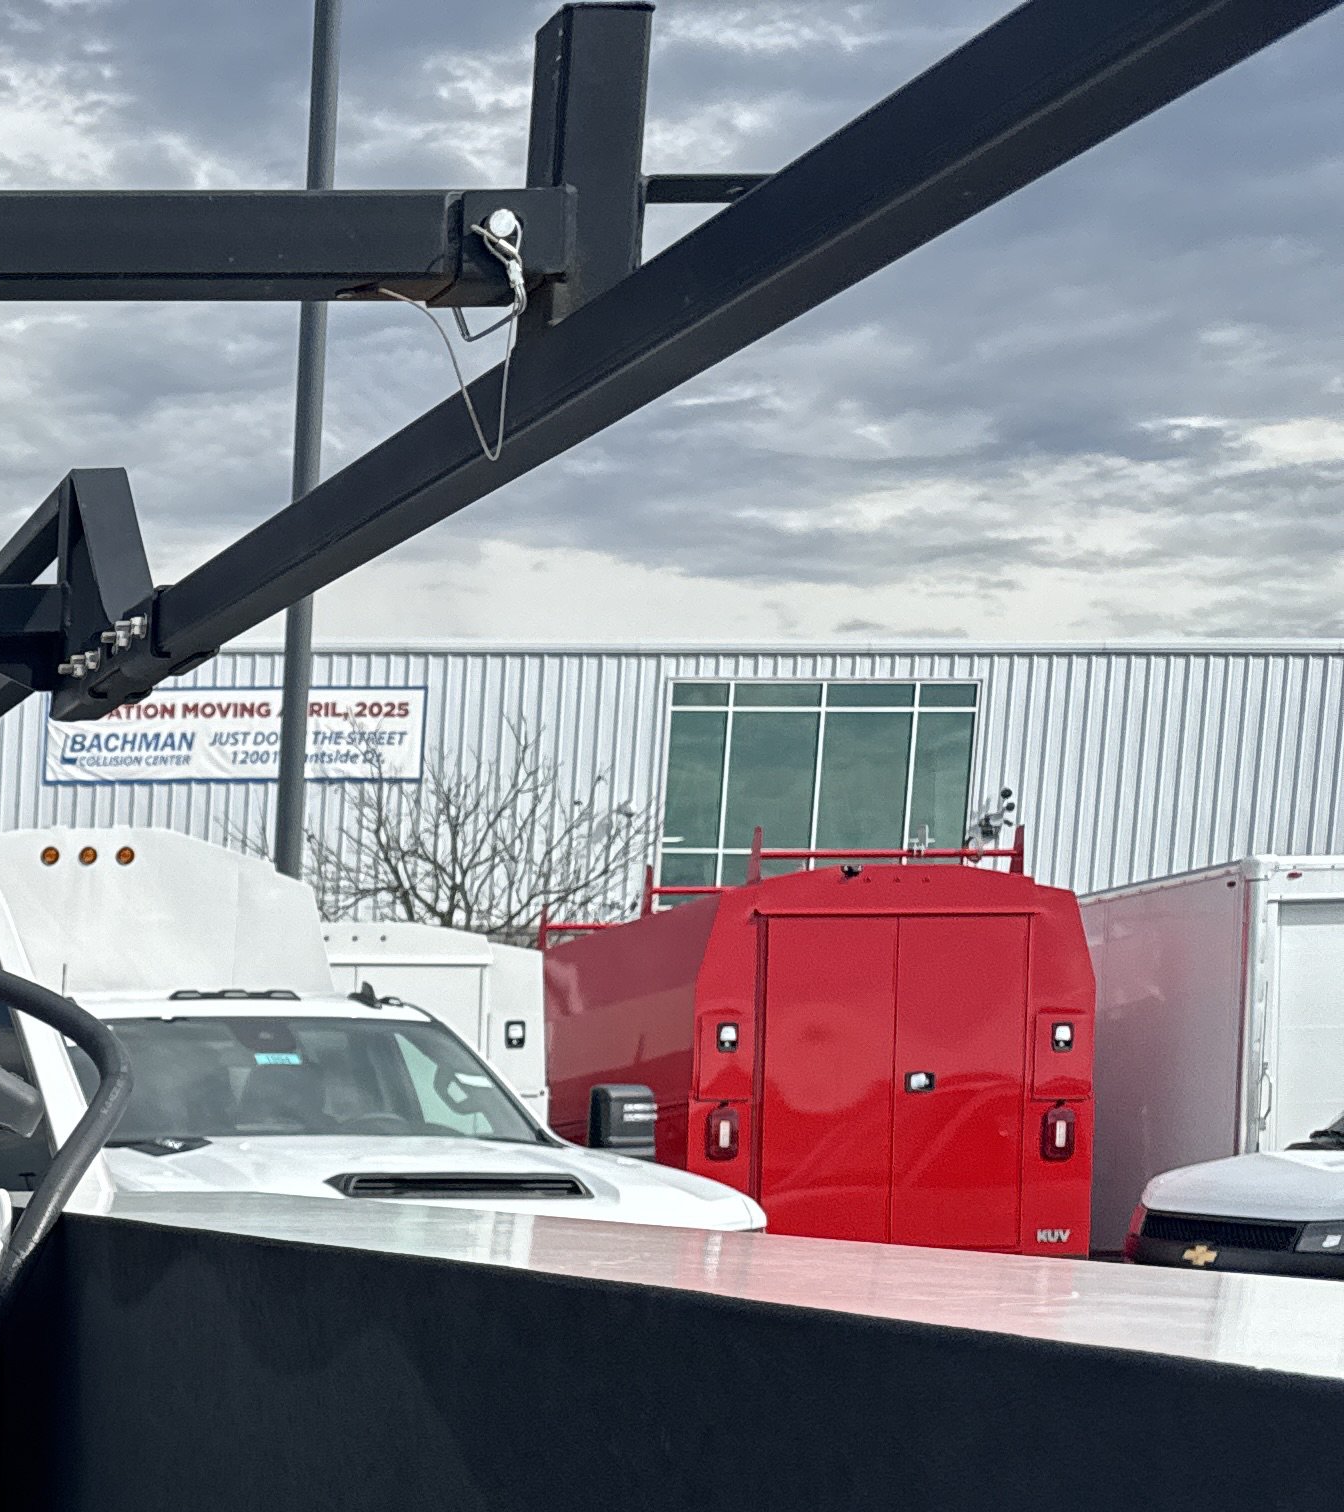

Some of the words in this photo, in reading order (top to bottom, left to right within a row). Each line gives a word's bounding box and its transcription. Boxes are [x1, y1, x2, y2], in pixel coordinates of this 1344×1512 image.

[107, 703, 175, 720] ATION
[181, 702, 271, 719] MOVING
[353, 702, 409, 718] 2025
[69, 731, 195, 752] BACHMAN
[209, 731, 250, 746] JUST
[253, 731, 279, 746] DO
[312, 731, 343, 746] THE
[346, 731, 408, 746] STREET
[77, 755, 143, 767] COLLISION
[144, 754, 192, 767] CENTER
[1036, 1228, 1071, 1243] KUV
